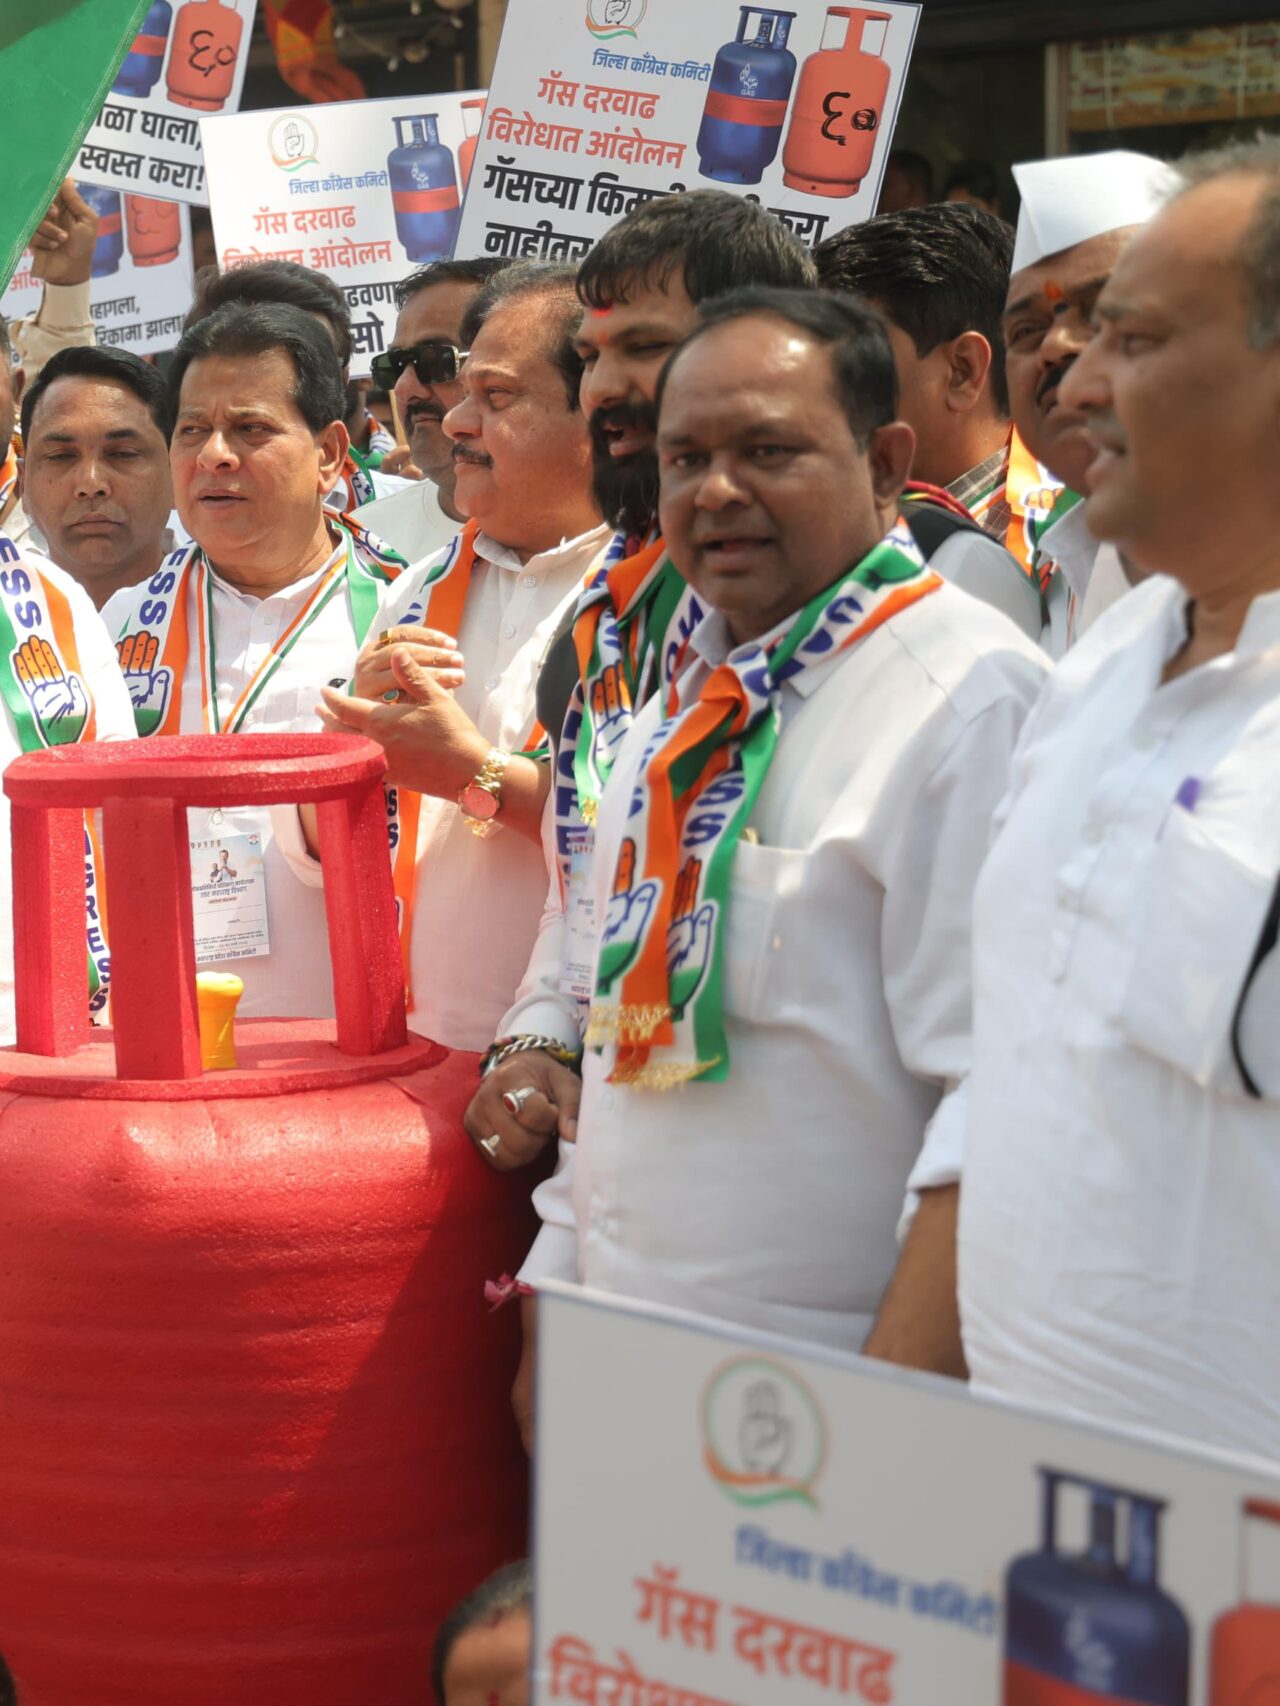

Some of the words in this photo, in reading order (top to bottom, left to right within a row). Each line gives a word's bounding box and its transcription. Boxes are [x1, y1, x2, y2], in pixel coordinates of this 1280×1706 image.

[592, 48, 628, 71] जिल्हा
[670, 60, 713, 82] कमिटी
[537, 70, 578, 109] गॅस
[583, 85, 660, 120] दरवाढ
[141, 110, 202, 151] घाला,
[486, 107, 583, 155] विरोधात
[585, 126, 686, 169] आंदोलन
[79, 143, 146, 180] स्वस्त
[148, 156, 205, 191] करा!
[289, 178, 319, 195] जिल्हा
[355, 170, 388, 188] कमिटी
[483, 154, 585, 211] गॅसच्या
[252, 206, 288, 236] गॅस
[291, 205, 357, 234] दरवाढ
[310, 237, 392, 270] आंदोलन
[634, 1561, 721, 1653] गॅस
[731, 1603, 898, 1706] दरवाढ
